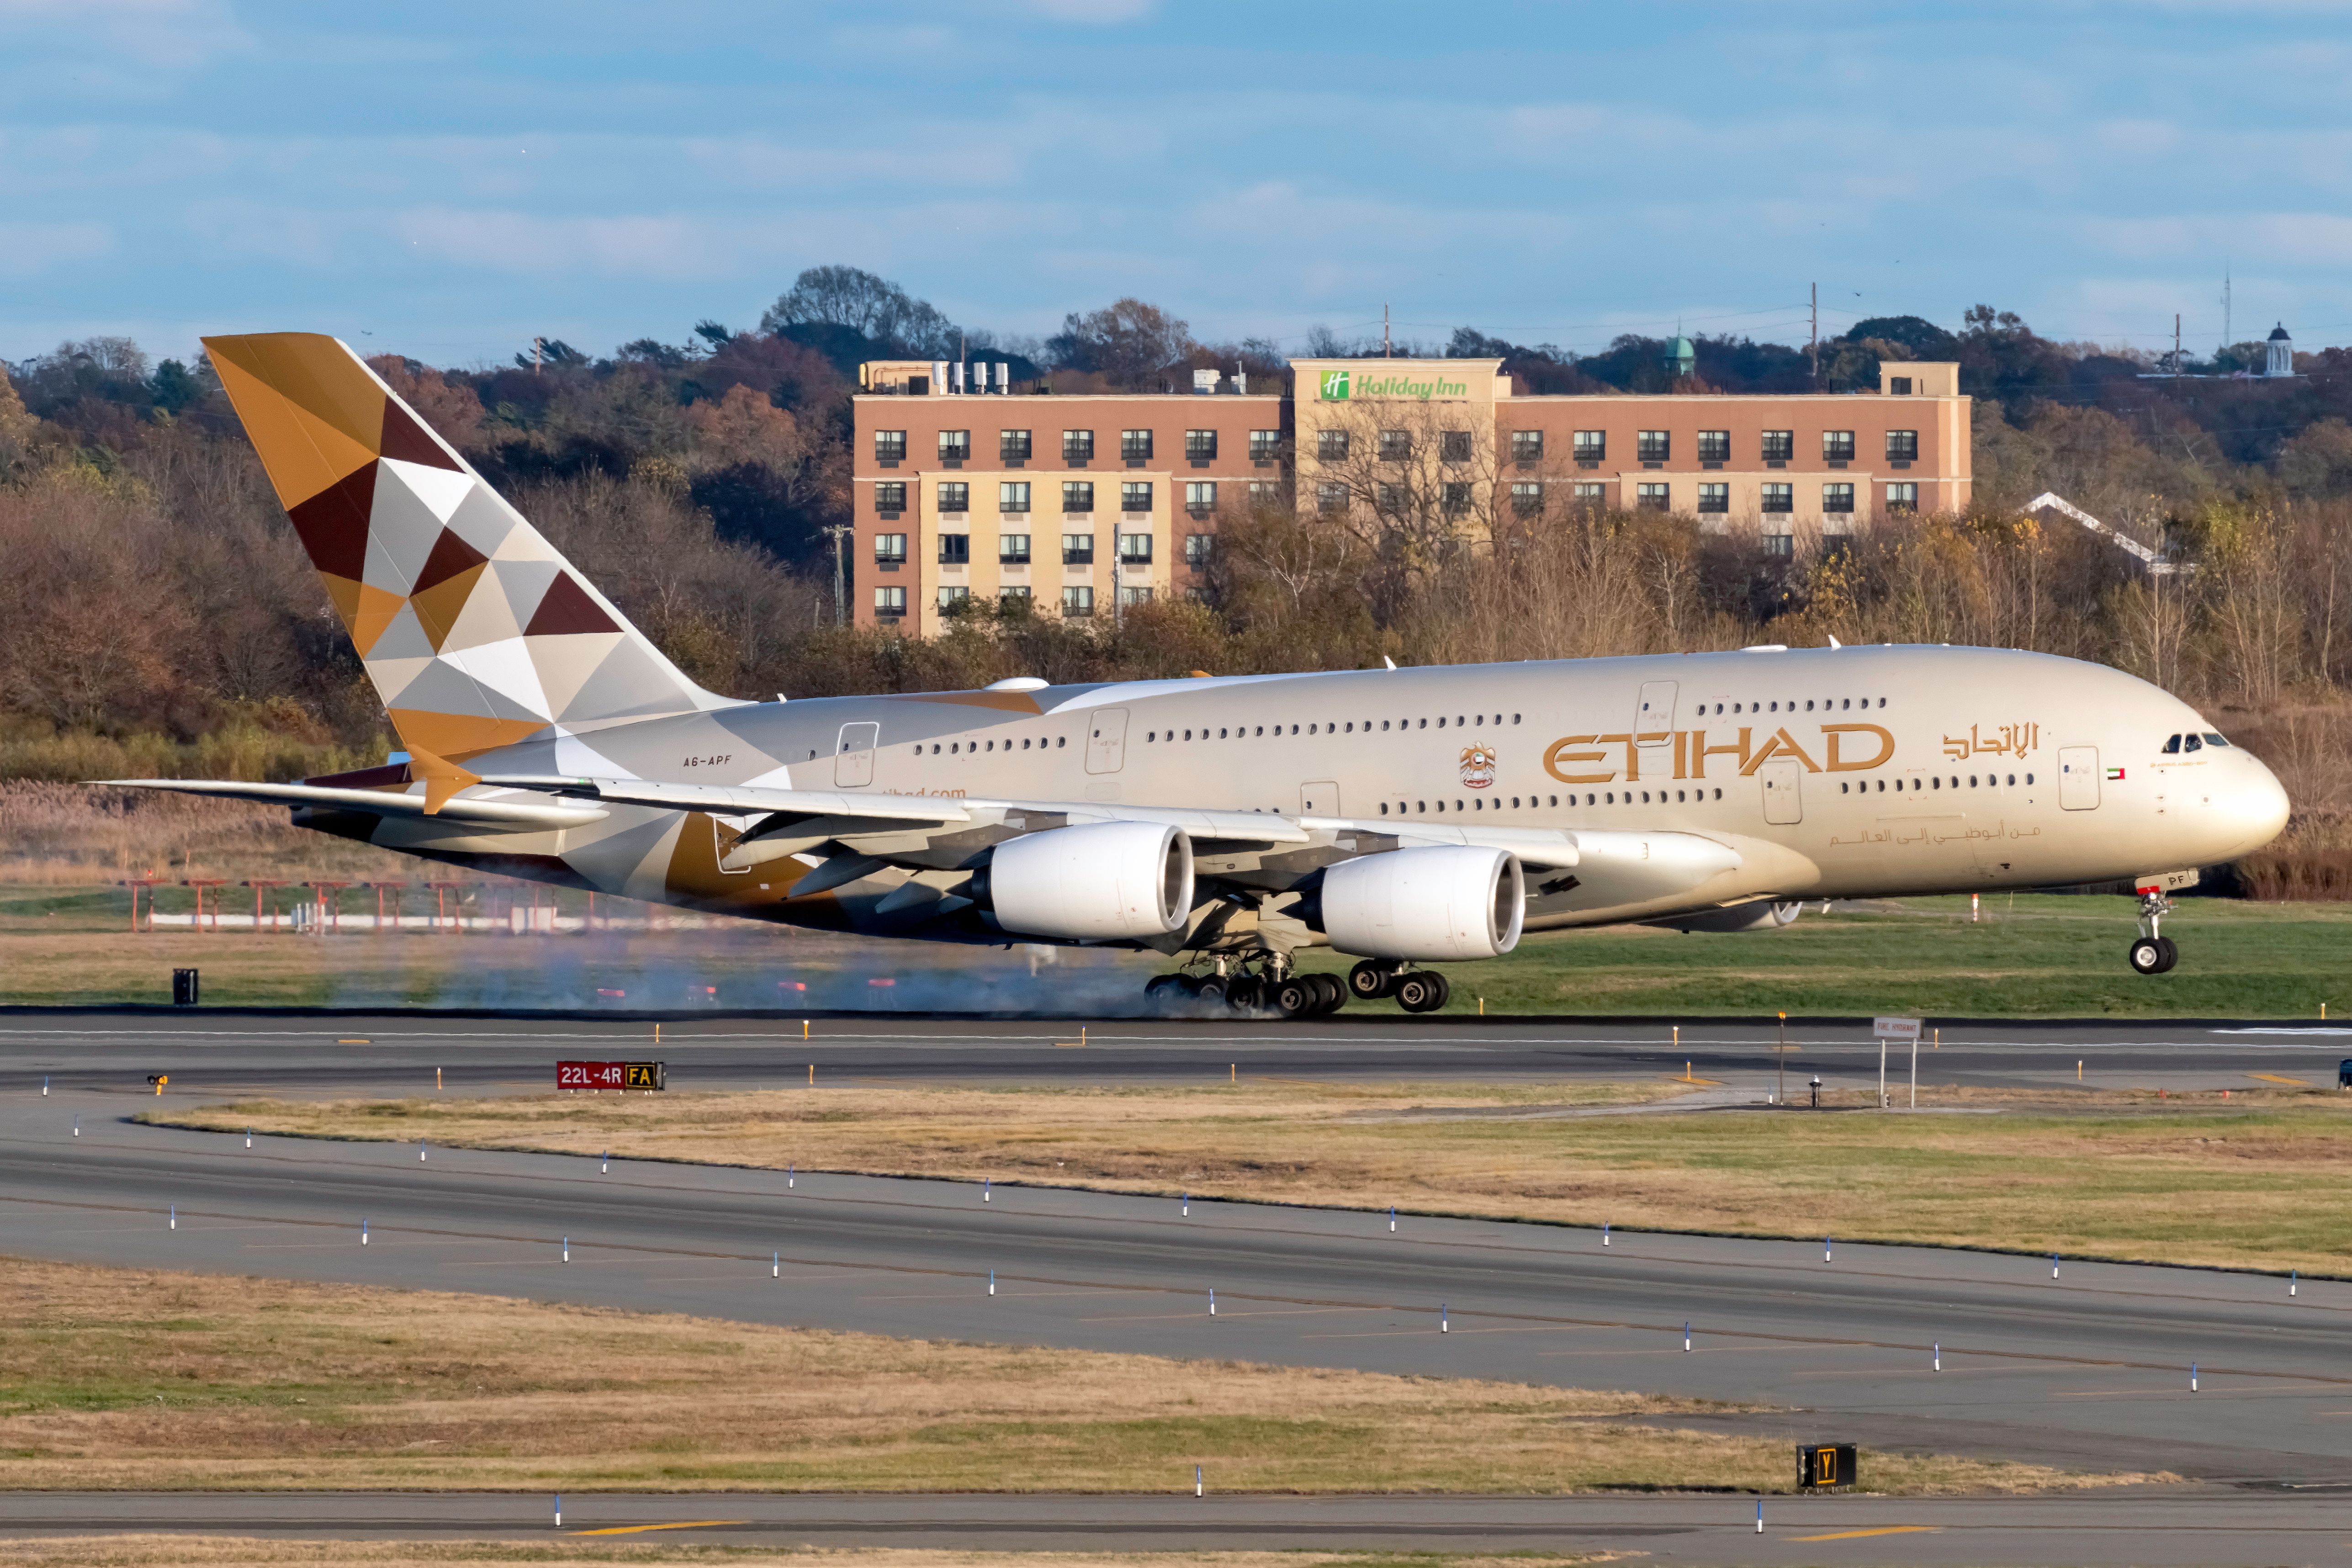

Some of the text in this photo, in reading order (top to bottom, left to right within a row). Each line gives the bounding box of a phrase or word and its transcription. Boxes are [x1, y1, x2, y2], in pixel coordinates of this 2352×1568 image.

[1356, 375, 1467, 400] Holiday Inn
[683, 755, 731, 767] A6-APF
[1543, 724, 1895, 783] ETIHAD
[2168, 875, 2184, 885] PF
[562, 1067, 651, 1084] 22L-4R FA
[1823, 1454, 1831, 1478] Y
